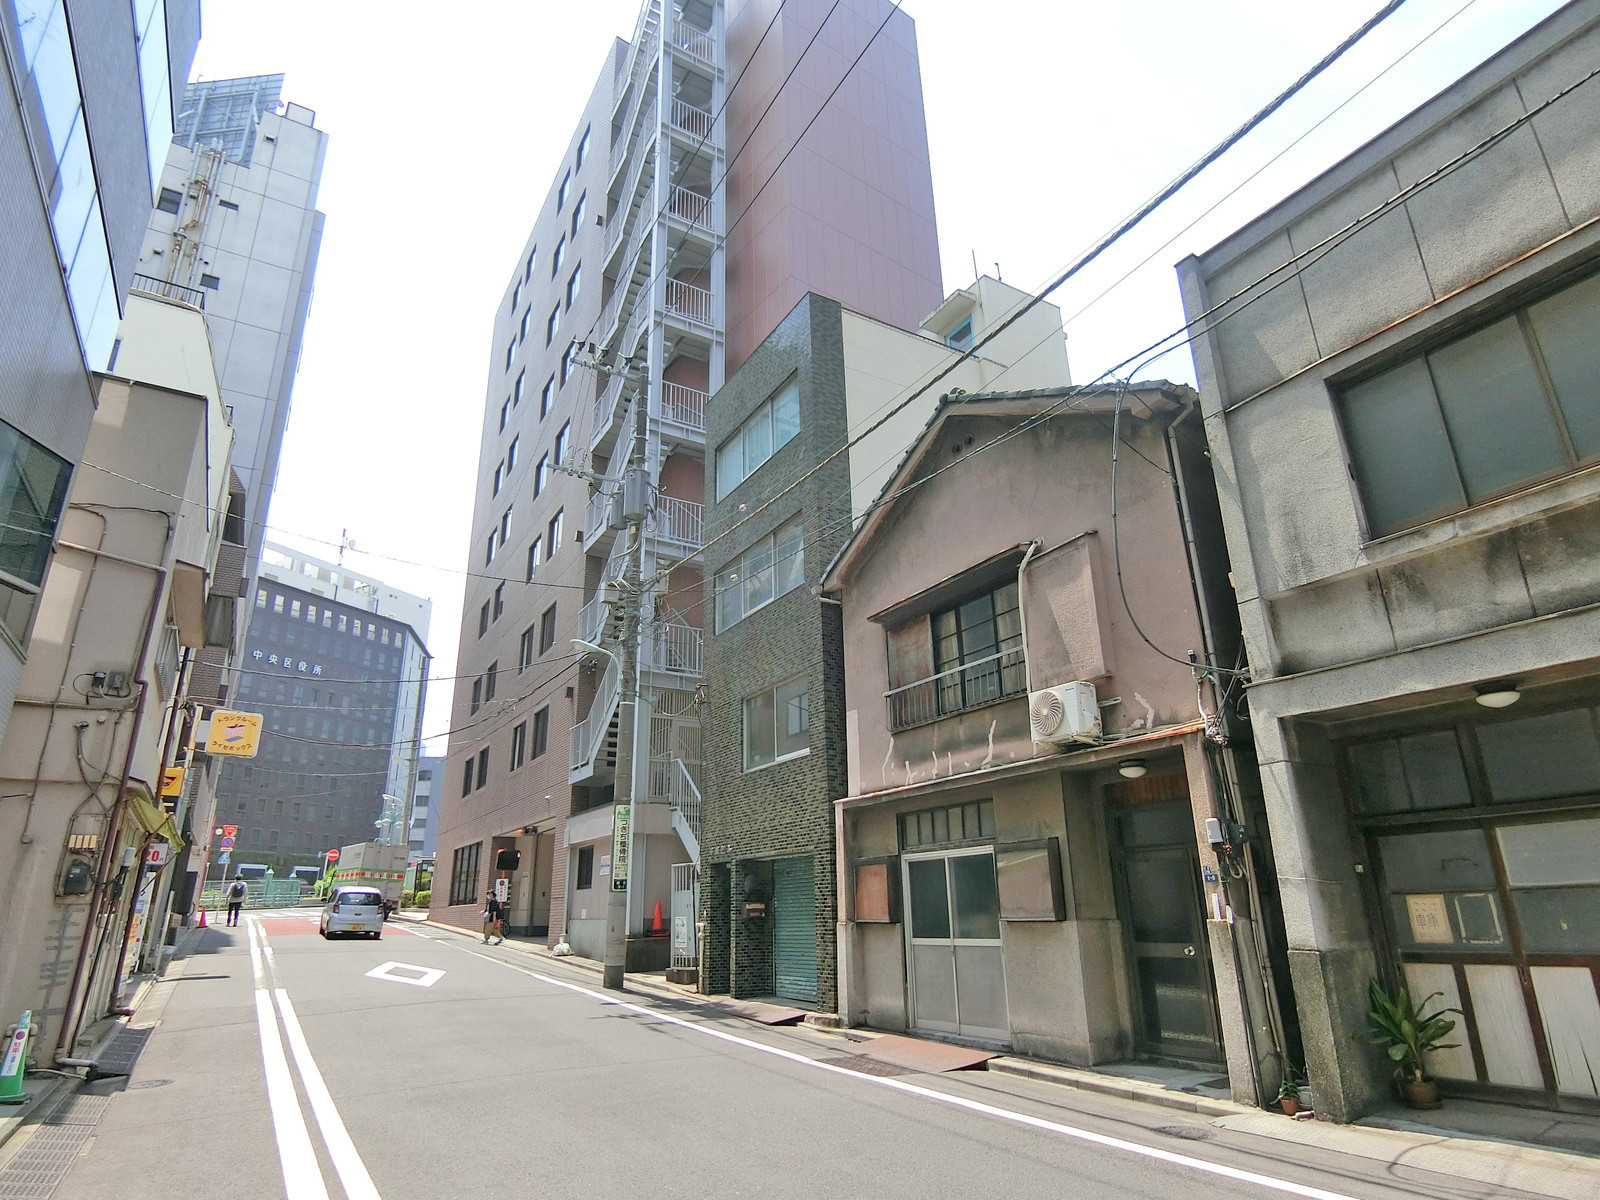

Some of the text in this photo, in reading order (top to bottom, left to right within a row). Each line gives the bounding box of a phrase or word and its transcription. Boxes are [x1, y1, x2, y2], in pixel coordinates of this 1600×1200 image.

[253, 650, 323, 675] 中央区役所
[217, 716, 257, 727] トランクルーム
